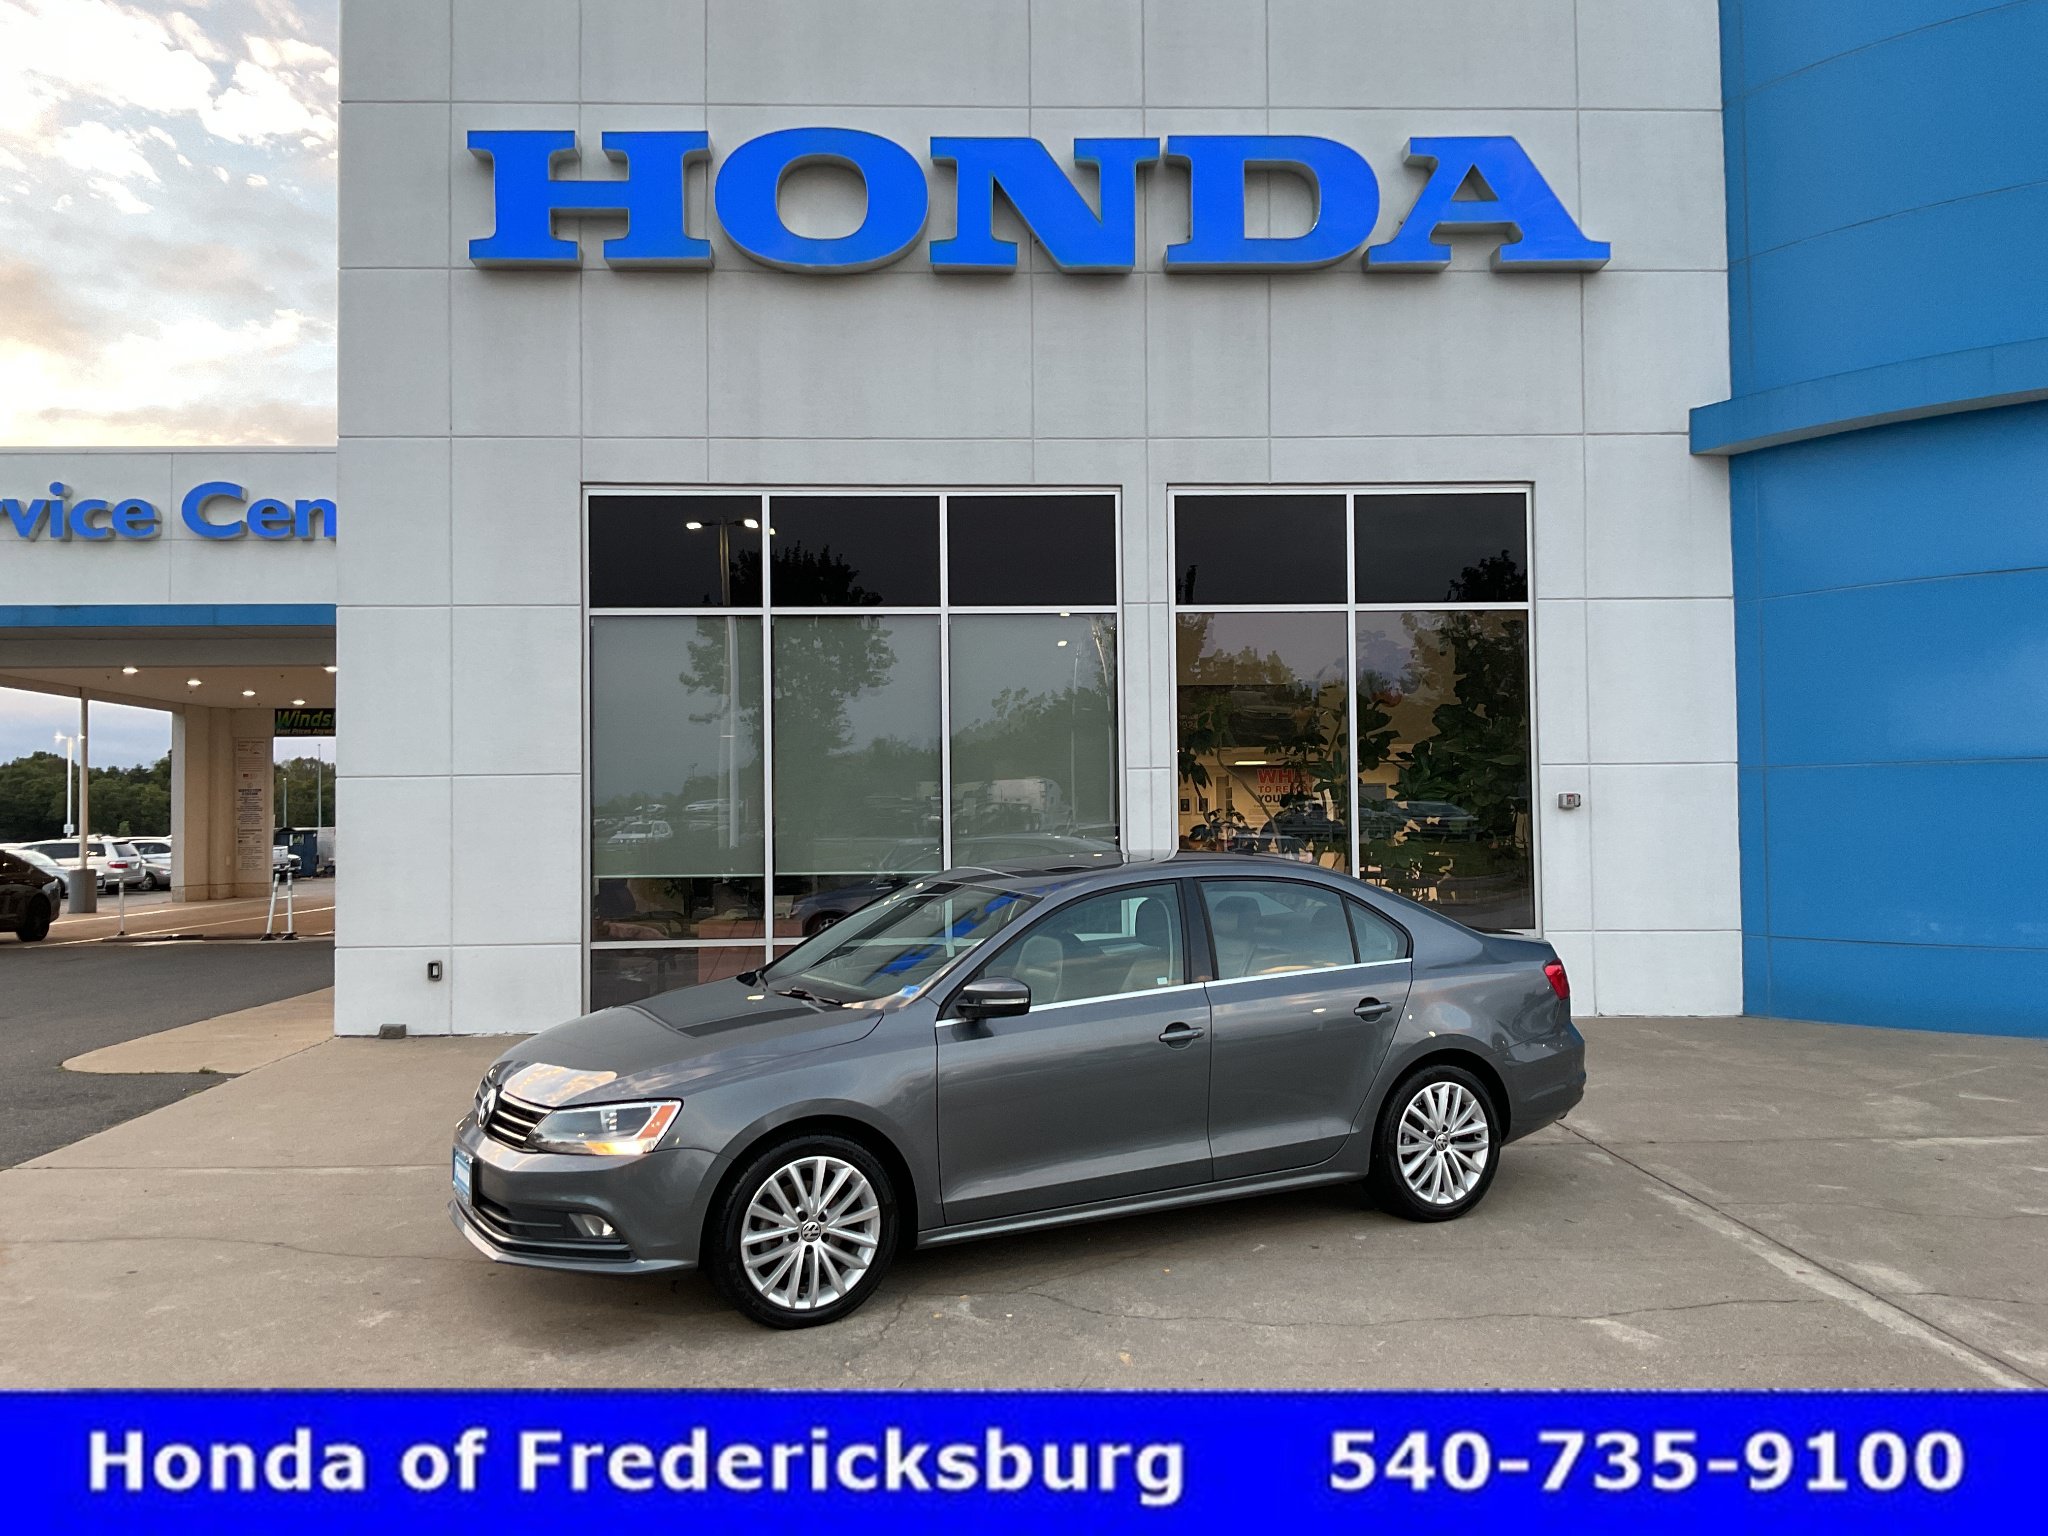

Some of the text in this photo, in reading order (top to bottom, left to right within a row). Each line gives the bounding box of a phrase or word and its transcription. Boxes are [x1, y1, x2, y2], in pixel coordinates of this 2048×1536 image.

[467, 127, 1611, 271] HONDA
[0, 481, 157, 538] vice
[277, 710, 336, 728] Winds
[1258, 785, 1272, 794] TO
